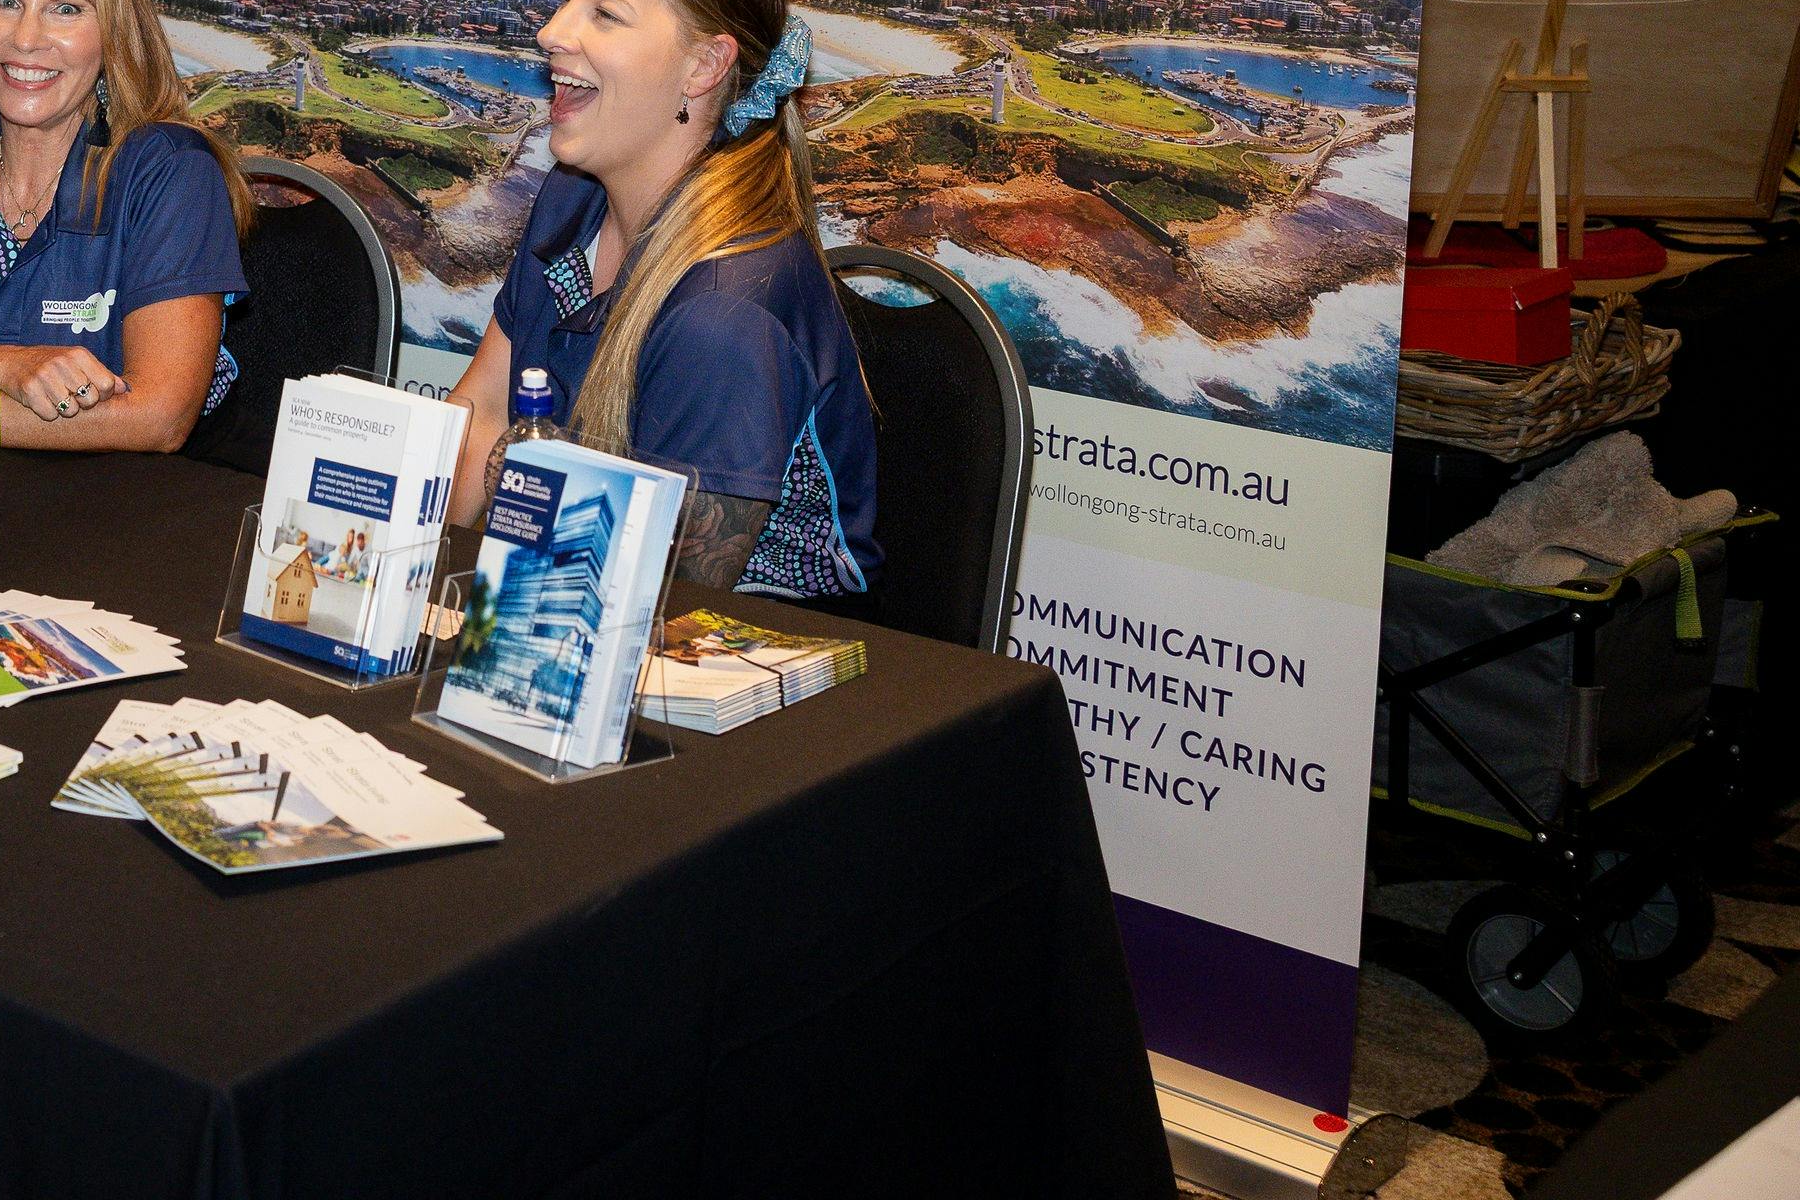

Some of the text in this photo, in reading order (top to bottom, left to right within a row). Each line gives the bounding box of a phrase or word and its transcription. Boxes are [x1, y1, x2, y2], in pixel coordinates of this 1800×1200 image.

[290, 404, 322, 421] WHO'S
[325, 412, 395, 437] RESPONSIBLE?
[294, 419, 309, 428] guide
[318, 422, 342, 434] common
[343, 428, 368, 442] property
[323, 468, 355, 480] comprehensive
[356, 474, 367, 483] guide
[1033, 424, 1289, 506] strata.com.au
[316, 483, 335, 494] guidance
[342, 489, 352, 497] who
[356, 493, 381, 504] responsible
[317, 476, 336, 484] common
[336, 480, 355, 490] property
[368, 486, 377, 494] and
[314, 491, 324, 499] their
[325, 494, 352, 506] maintenance
[353, 500, 362, 508] and
[493, 514, 543, 534] STRATA INSURANCE
[494, 506, 532, 522] BEST PRACTICE
[1029, 482, 1286, 551] wollongong-strata.com.au
[490, 522, 538, 542] DISCLOSURE GUIDE
[1010, 591, 1306, 688] OMMUNICATION
[1007, 636, 1233, 719] OMMITMENT
[1069, 698, 1327, 793] THY / CARING
[1081, 751, 1220, 812] STENCY
